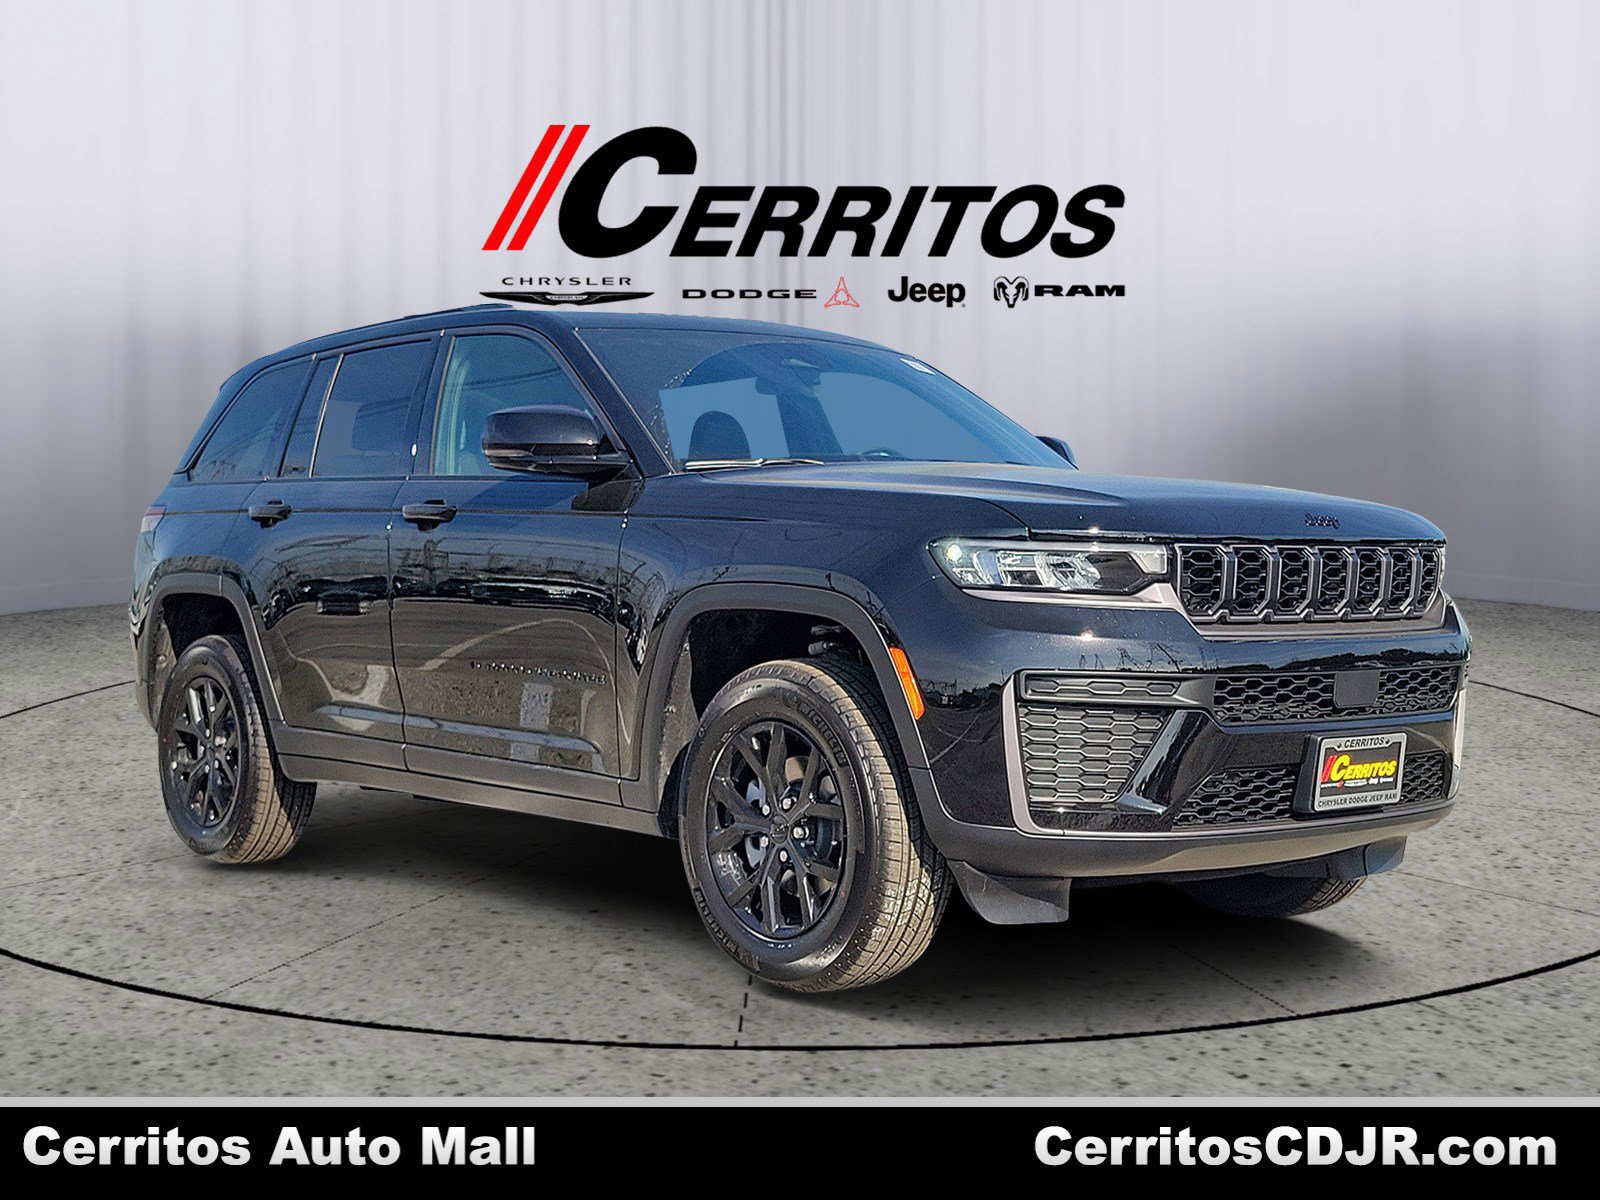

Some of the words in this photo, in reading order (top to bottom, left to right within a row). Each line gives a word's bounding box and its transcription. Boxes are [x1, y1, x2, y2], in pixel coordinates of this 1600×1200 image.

[1344, 737, 1385, 749] CERRITOS
[1330, 754, 1397, 782] CERRITOS
[1318, 798, 1348, 808] CHRYSLER
[1348, 796, 1368, 804] DODGE
[1369, 794, 1384, 802] JEEP
